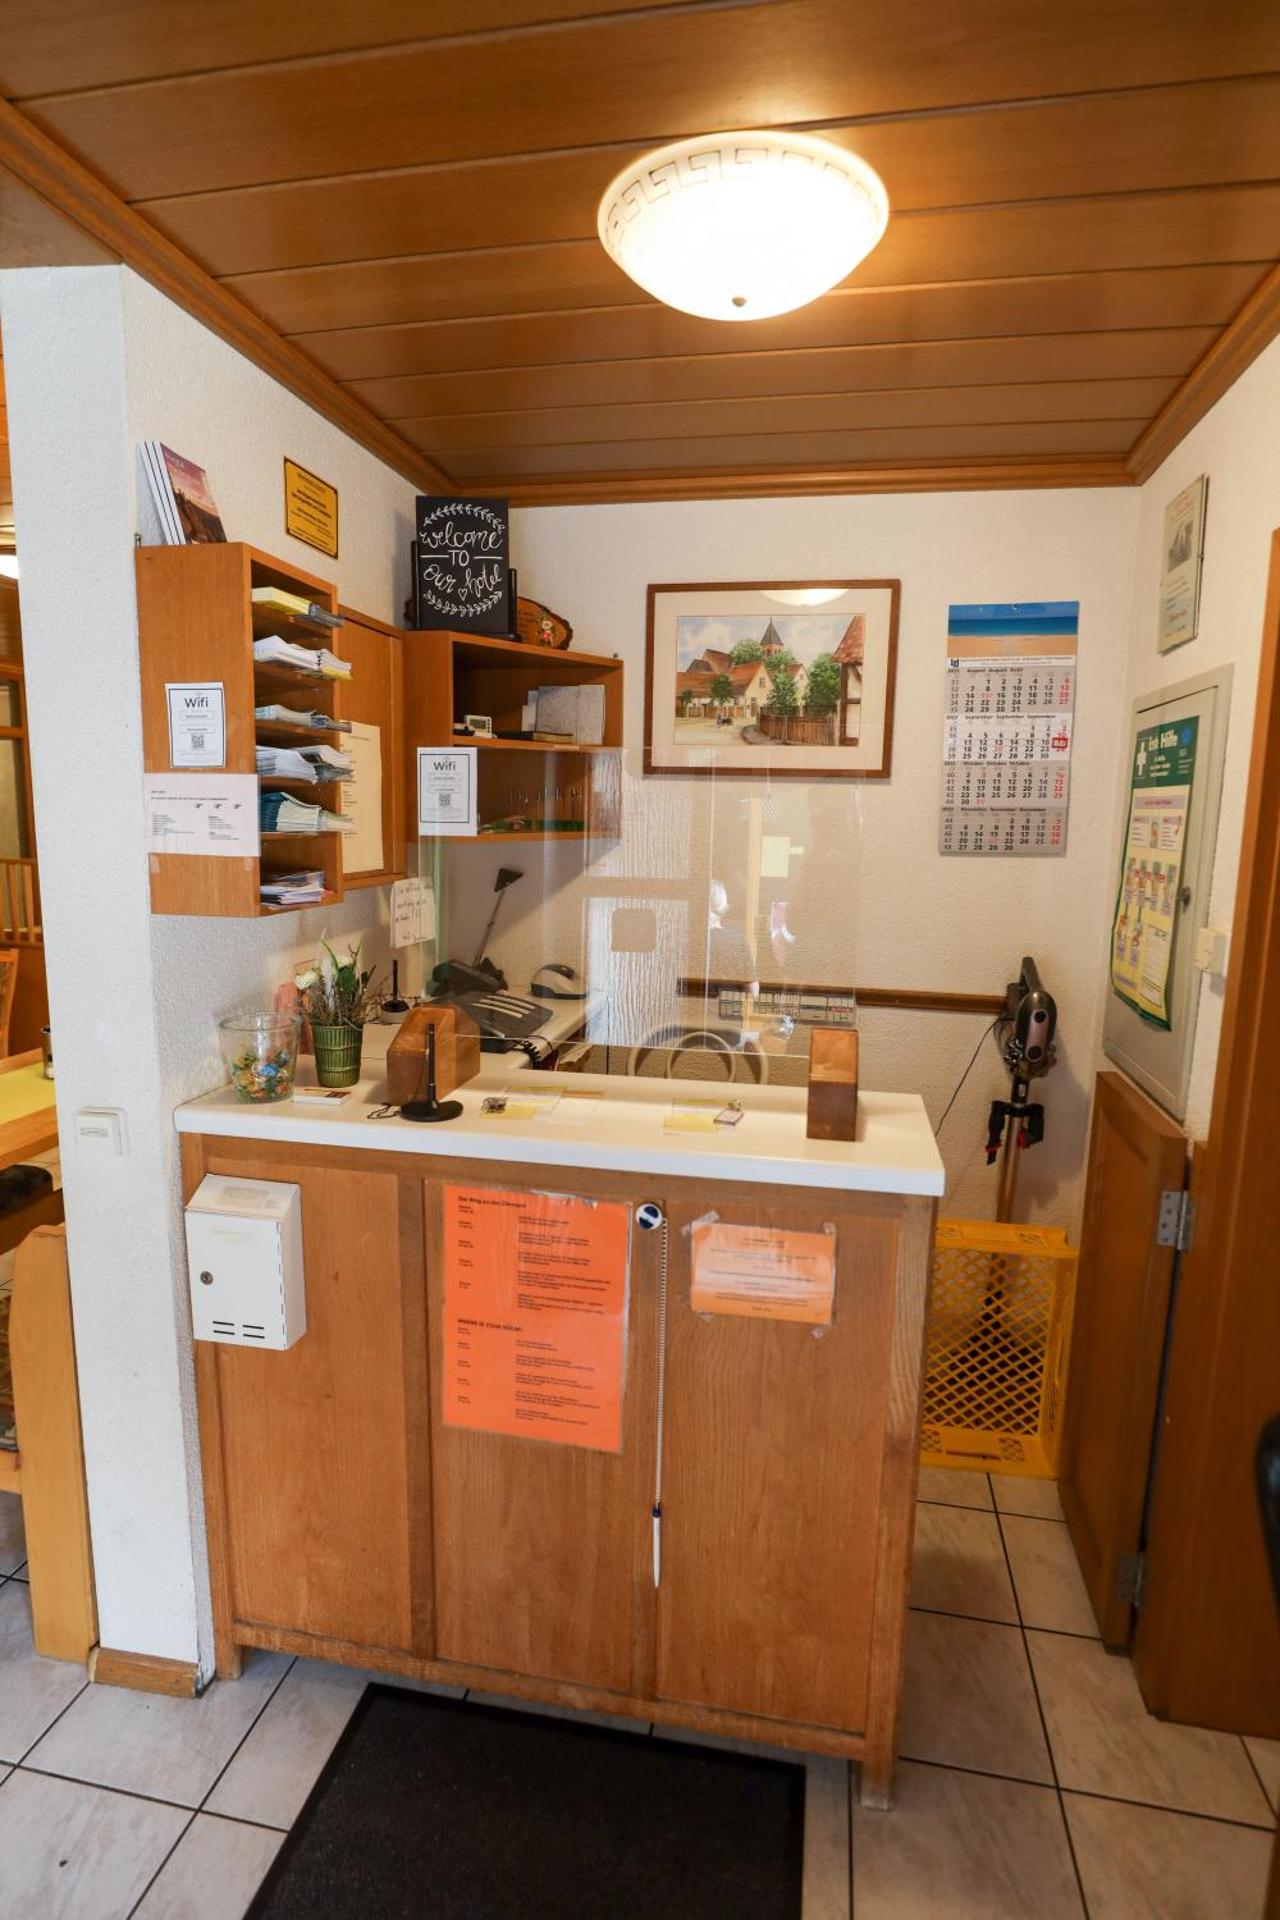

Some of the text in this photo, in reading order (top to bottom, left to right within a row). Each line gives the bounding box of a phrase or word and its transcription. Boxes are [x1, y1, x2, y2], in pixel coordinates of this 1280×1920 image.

[420, 521, 502, 551] welcome
[448, 550, 469, 566] TO
[184, 697, 209, 708] Wifi
[433, 760, 457, 772] Wifi
